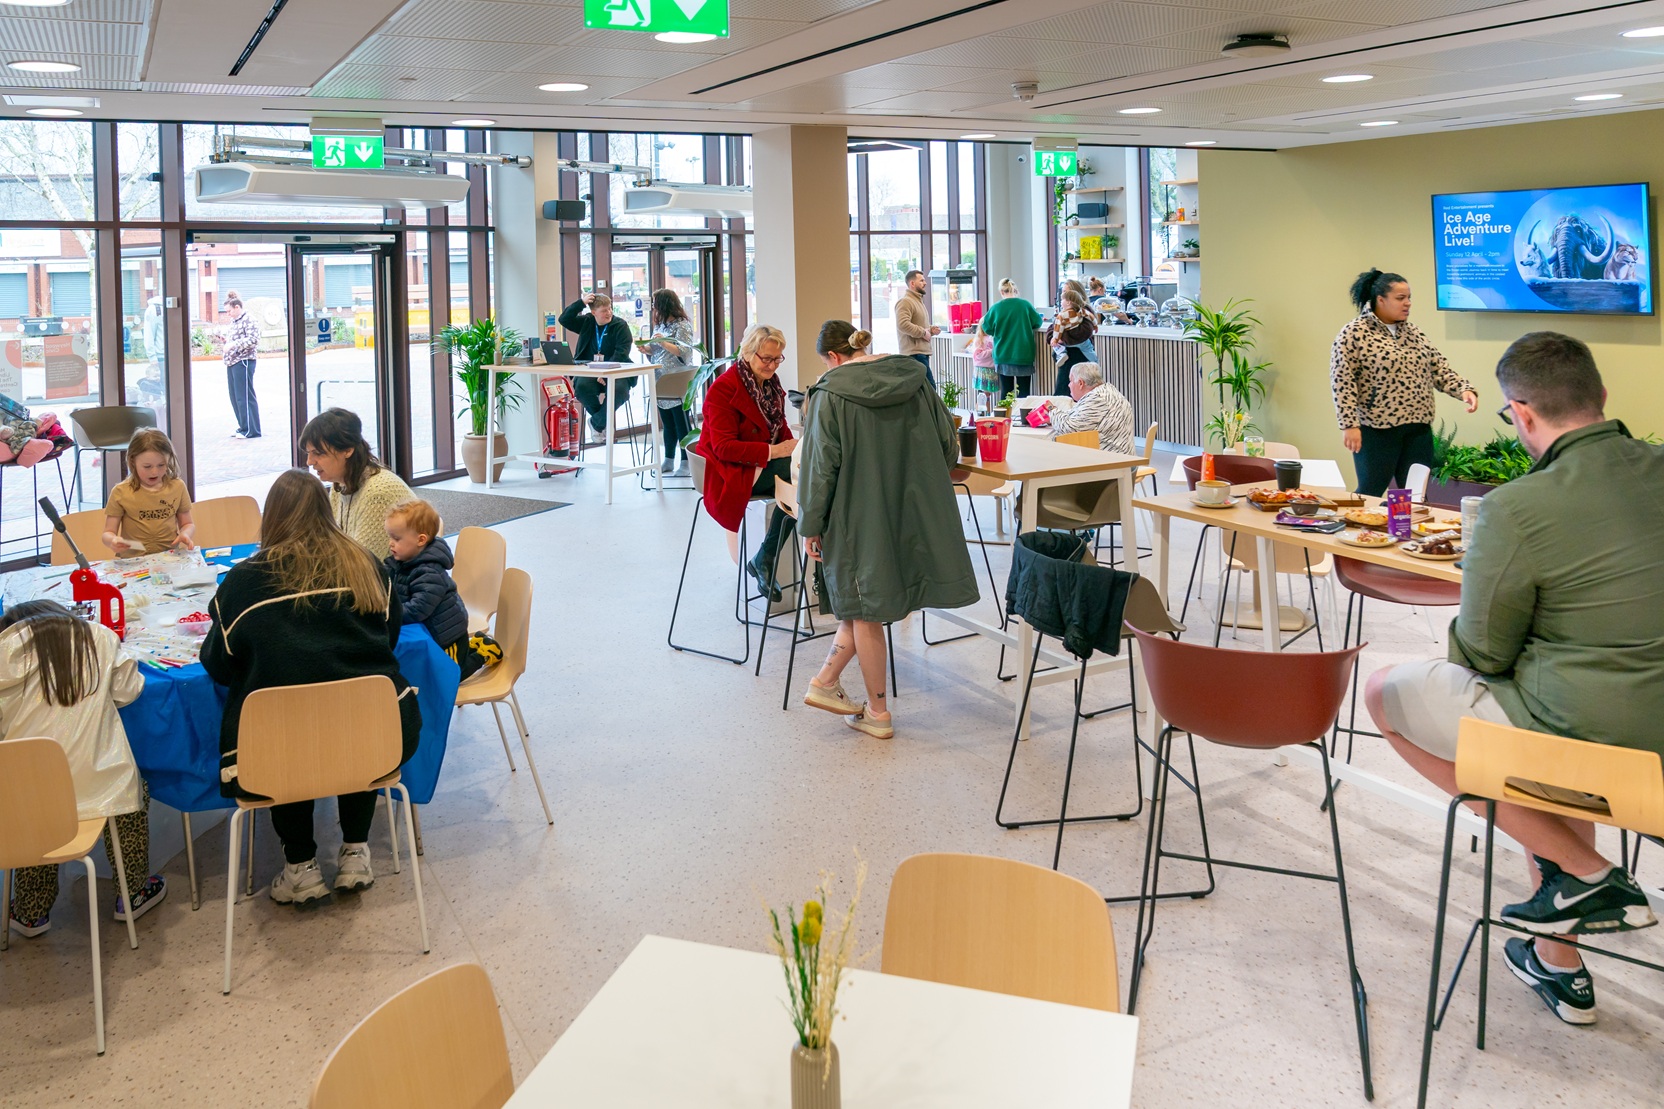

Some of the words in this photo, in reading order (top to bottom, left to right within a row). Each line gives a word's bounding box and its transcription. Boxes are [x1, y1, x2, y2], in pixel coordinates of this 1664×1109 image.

[1443, 212, 1462, 223] Ice
[1465, 211, 1491, 225] Age
[1444, 223, 1512, 234] Adventure
[1444, 235, 1474, 246] Live!
